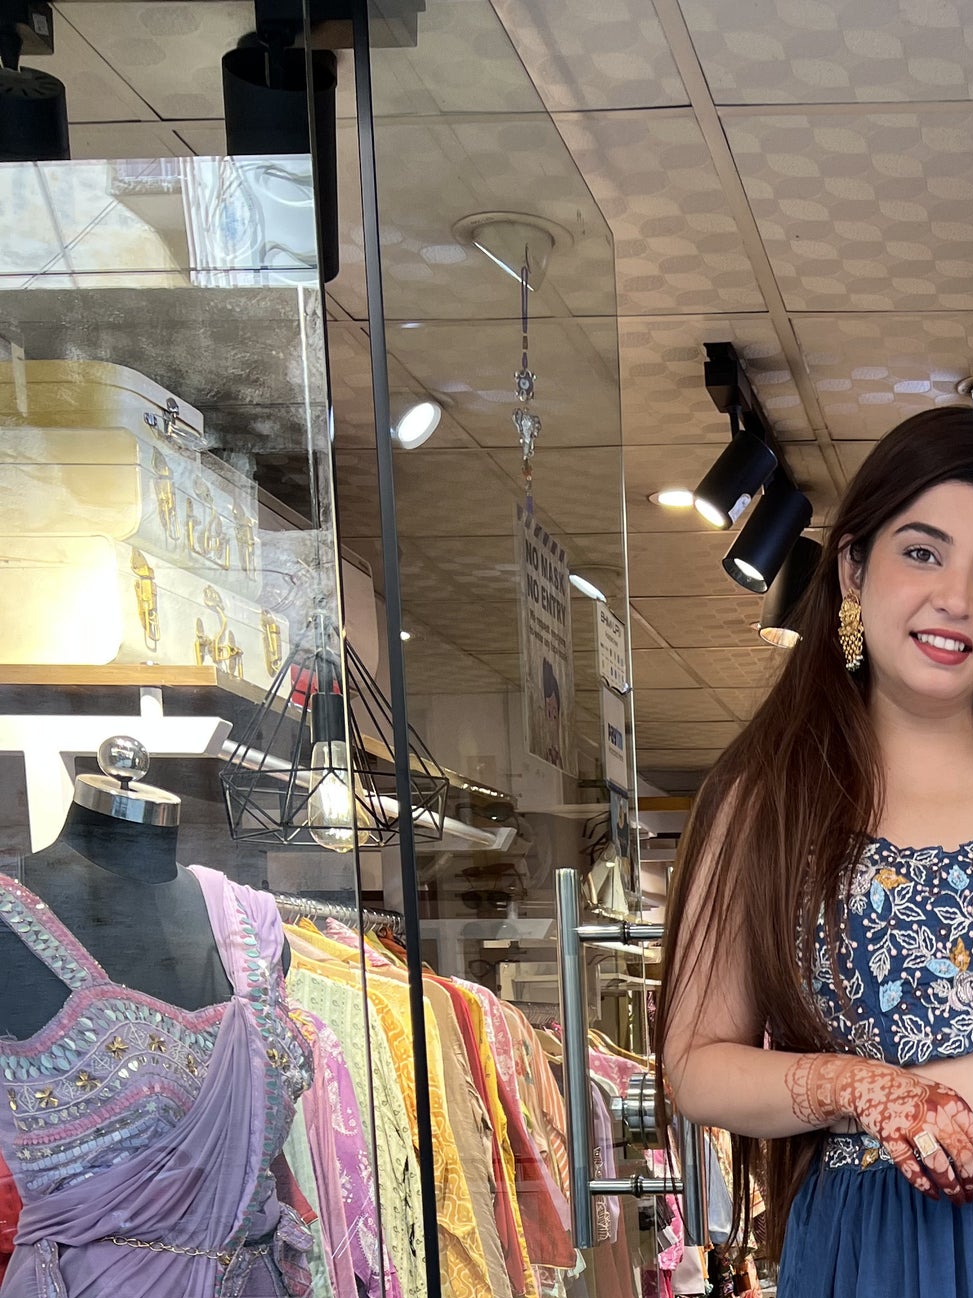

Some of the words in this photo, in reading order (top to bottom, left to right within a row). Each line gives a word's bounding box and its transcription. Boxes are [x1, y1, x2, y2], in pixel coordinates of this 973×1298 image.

[525, 538, 539, 571] NO
[541, 553, 566, 597] MASK
[527, 572, 539, 604] NO
[541, 585, 566, 627] ENTRY
